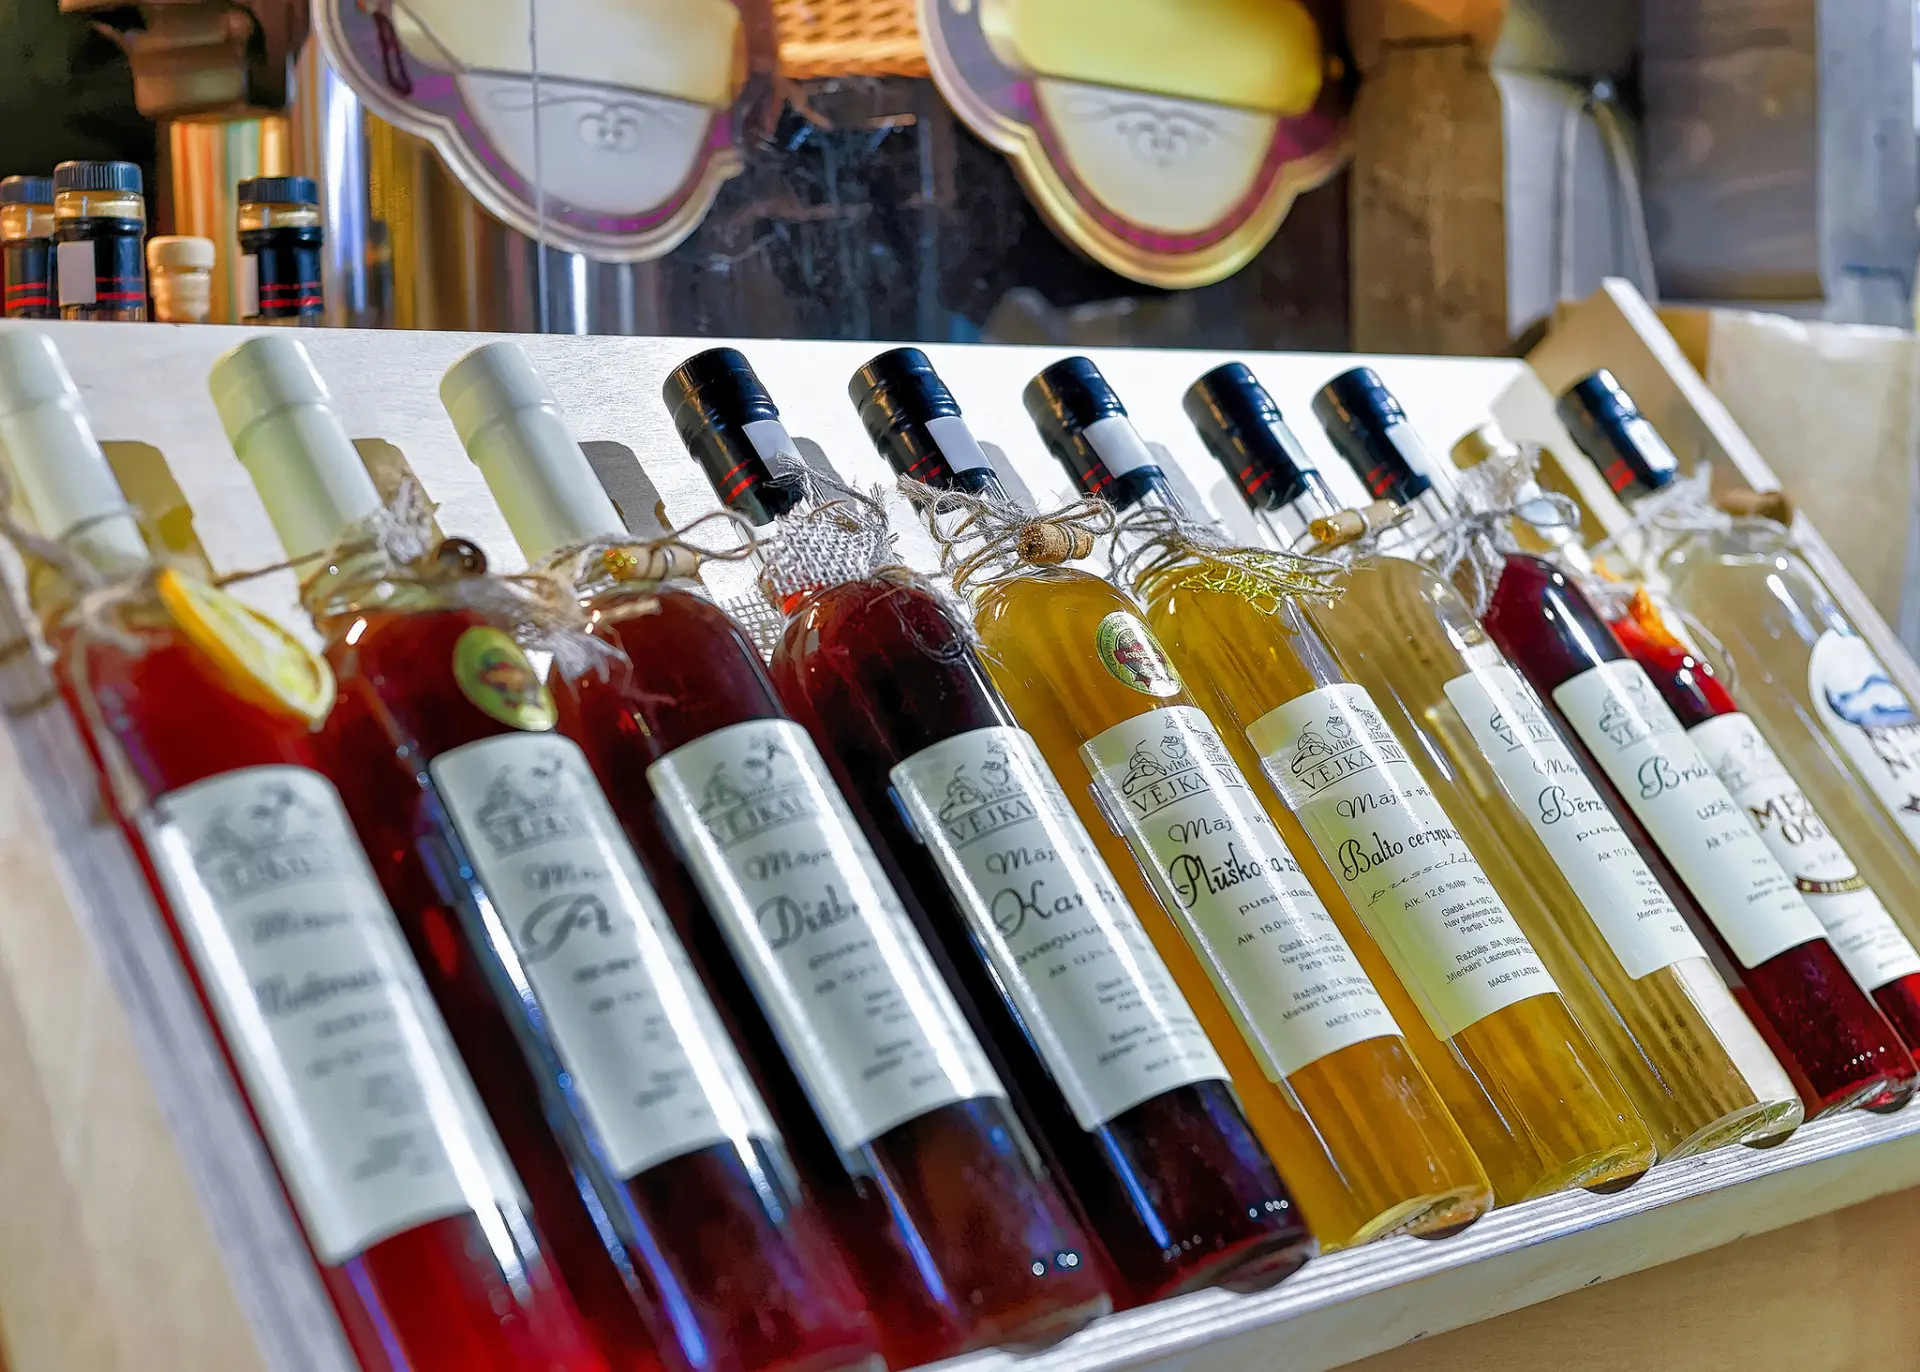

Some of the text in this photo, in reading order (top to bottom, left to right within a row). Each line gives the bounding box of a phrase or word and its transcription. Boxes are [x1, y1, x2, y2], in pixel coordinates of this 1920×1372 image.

[1331, 737, 1357, 752] VĪNA
[1164, 758, 1192, 773] VĪNA
[1336, 789, 1413, 819] Mājs
[1538, 785, 1604, 825] Bērz
[1338, 832, 1404, 881] Balto
[1424, 885, 1446, 899] 12,6
[1443, 918, 1460, 930] Nav
[1460, 921, 1484, 935] Partija
[1489, 938, 1503, 950] SIA
[1483, 948, 1516, 964] Laucienes
[1487, 974, 1512, 989] MADE
[1512, 968, 1520, 979] IN
